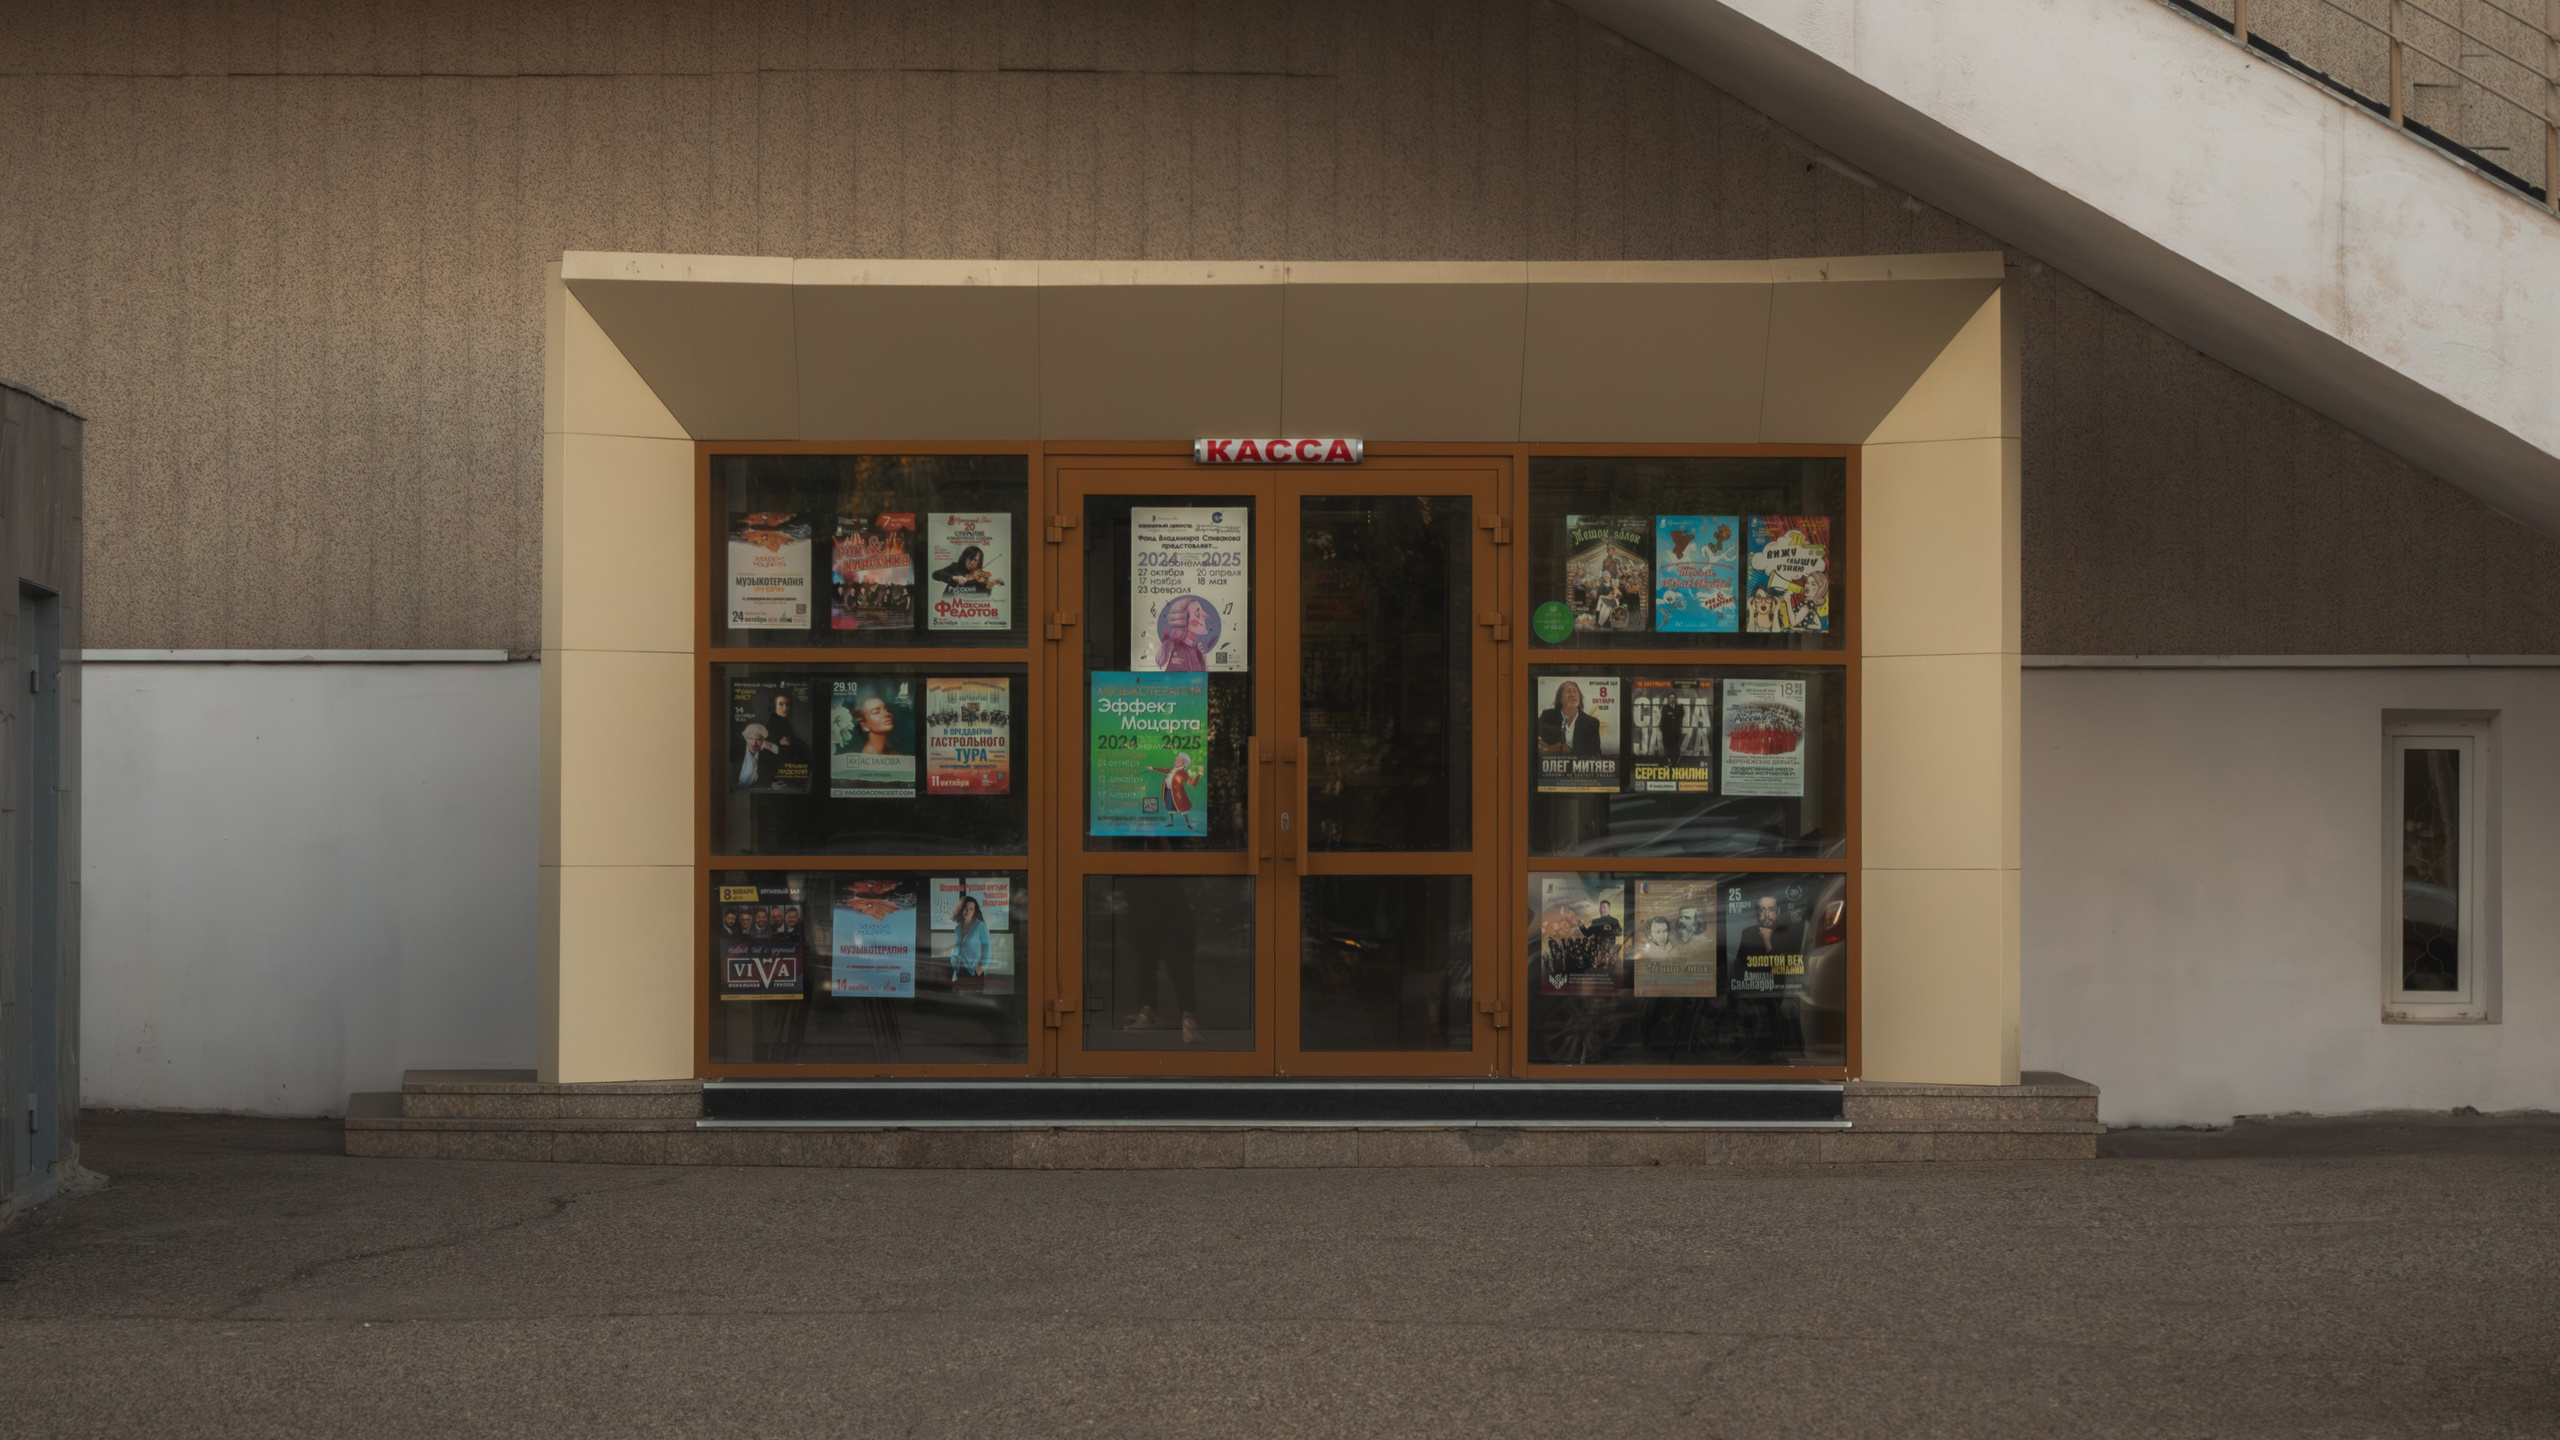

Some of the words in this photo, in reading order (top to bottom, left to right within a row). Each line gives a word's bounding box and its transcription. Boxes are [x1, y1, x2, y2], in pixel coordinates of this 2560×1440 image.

[1207, 439, 1354, 462] КАССА
[882, 515, 891, 528] 7
[964, 522, 976, 531] 20
[1137, 534, 1157, 543] Фонд
[1158, 534, 1200, 543] Владимира
[1202, 534, 1242, 542] Спивакова
[1572, 528, 1609, 546] Мешок
[1613, 527, 1642, 545] яблок
[837, 545, 865, 559] РОК
[868, 536, 888, 557] &
[1767, 547, 1797, 559] ВИЖУ
[845, 554, 910, 572] КЛАССИКА
[1138, 552, 1178, 567] 2024
[1202, 552, 1242, 567] 2025
[1786, 557, 1818, 567] СЛЫШУ
[1137, 568, 1149, 577] 27
[1150, 568, 1185, 578] октября
[1196, 568, 1207, 577] 20
[1208, 570, 1242, 578] апреля
[1776, 564, 1805, 573] УЗНАЮ
[735, 577, 804, 587] МУЗЫКОТЕРАПИЯ
[1138, 578, 1148, 586] 17
[1150, 577, 1182, 587] ноября
[1197, 577, 1206, 586] 18
[1137, 586, 1149, 595] 23
[1150, 586, 1192, 595] февраля
[934, 600, 999, 618] Федотов
[952, 598, 991, 609] Максим
[732, 610, 744, 623] 24
[933, 617, 939, 626] 5
[833, 682, 858, 692] 29.10
[1599, 686, 1608, 698] 8
[1781, 682, 1794, 697] 18
[1097, 698, 1177, 716] Эффект
[1120, 715, 1202, 734] Моцарта
[950, 728, 993, 737] ПРЕДДВЕРИИ
[930, 736, 1006, 748] ГАСТРОЛЬНОГО
[1098, 734, 1138, 750] 2024
[1162, 734, 1202, 750] 2025
[861, 758, 902, 766] АСТАХОВА
[955, 748, 988, 765] ТУРА
[1542, 759, 1570, 773] ОЛЕГ
[1572, 759, 1616, 774] МИТЯЕВ
[1634, 765, 1671, 780] СЕРГЕЙ
[1671, 767, 1709, 780] ЖИЛИН
[931, 775, 940, 787] 11
[940, 778, 970, 788] октября
[724, 888, 731, 901] 8
[760, 887, 789, 895] ОРГАННЫЙ
[1728, 887, 1742, 901] 25
[840, 945, 908, 956] МУЗЫКОТЕРАПИЯ
[1747, 953, 1786, 968] ЗОЛОТОЙ
[1787, 954, 1805, 966] ВЕК
[733, 957, 791, 990] VIVA
[834, 978, 847, 991] 14
[1730, 979, 1774, 991] Сальвадор
